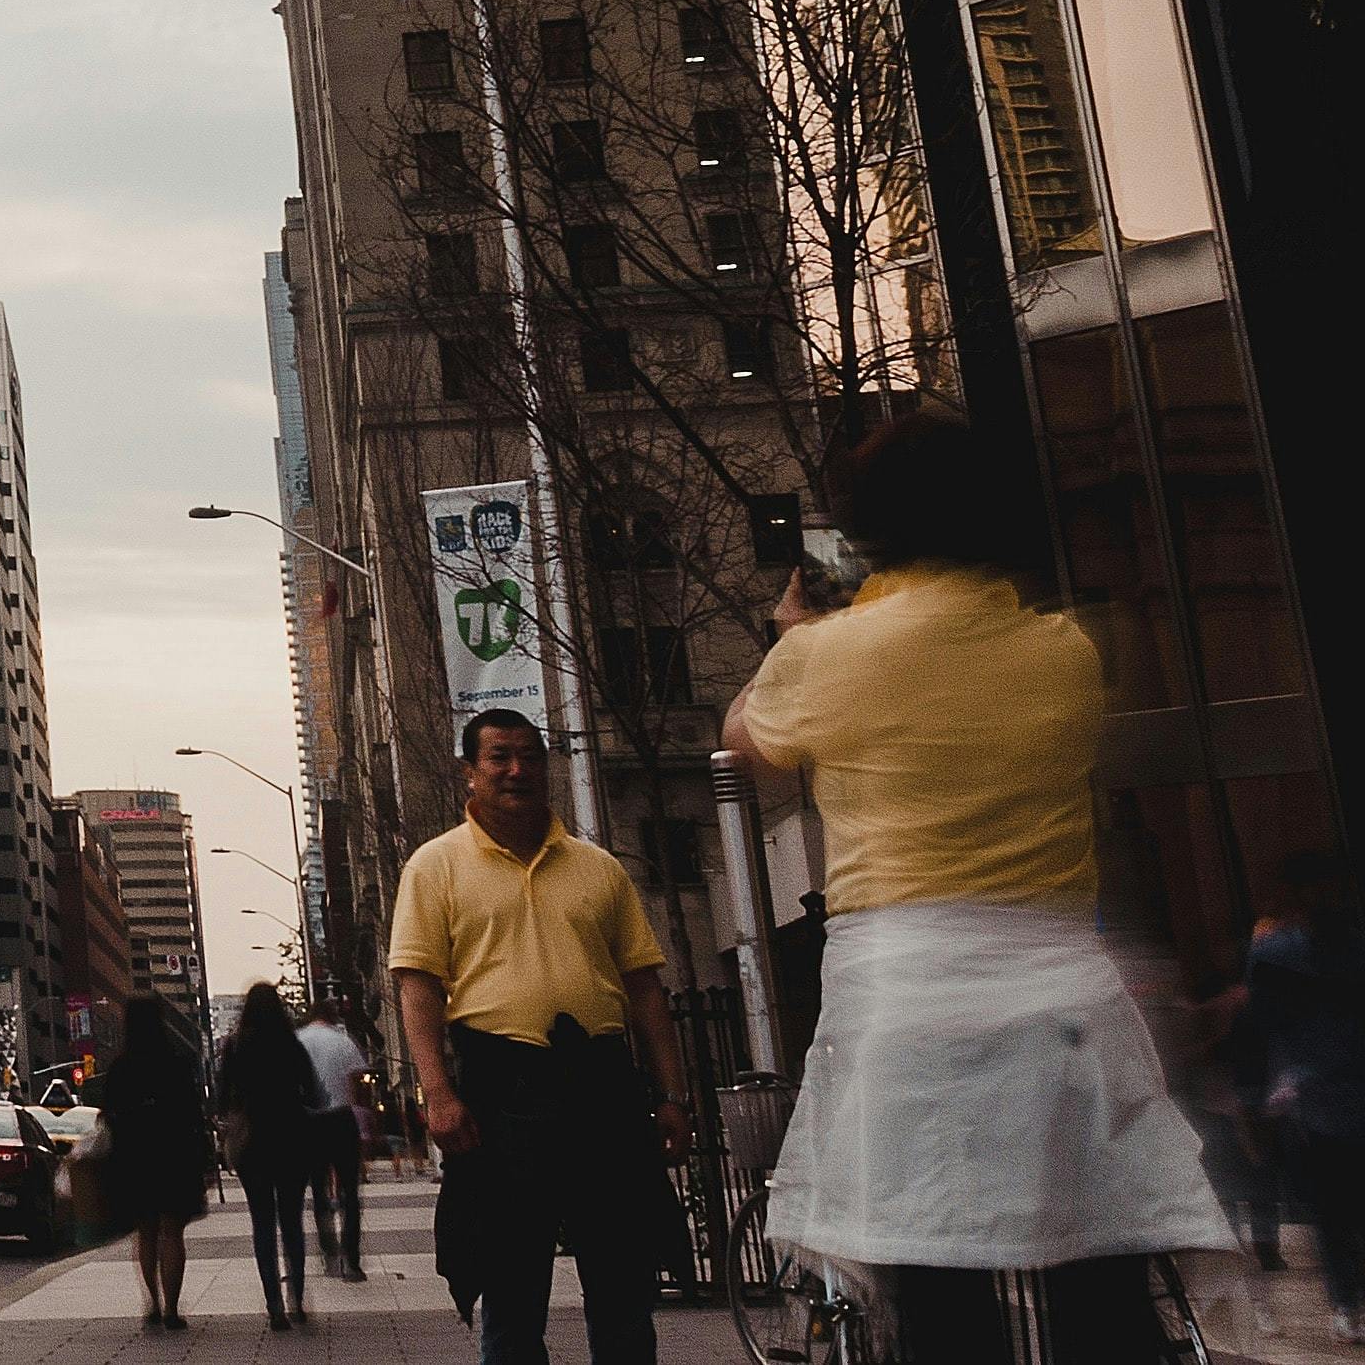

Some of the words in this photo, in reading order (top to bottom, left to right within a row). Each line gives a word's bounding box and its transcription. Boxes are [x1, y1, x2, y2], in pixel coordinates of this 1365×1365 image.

[458, 601, 514, 646] 7K
[458, 687, 523, 702] September
[527, 685, 539, 696] 15
